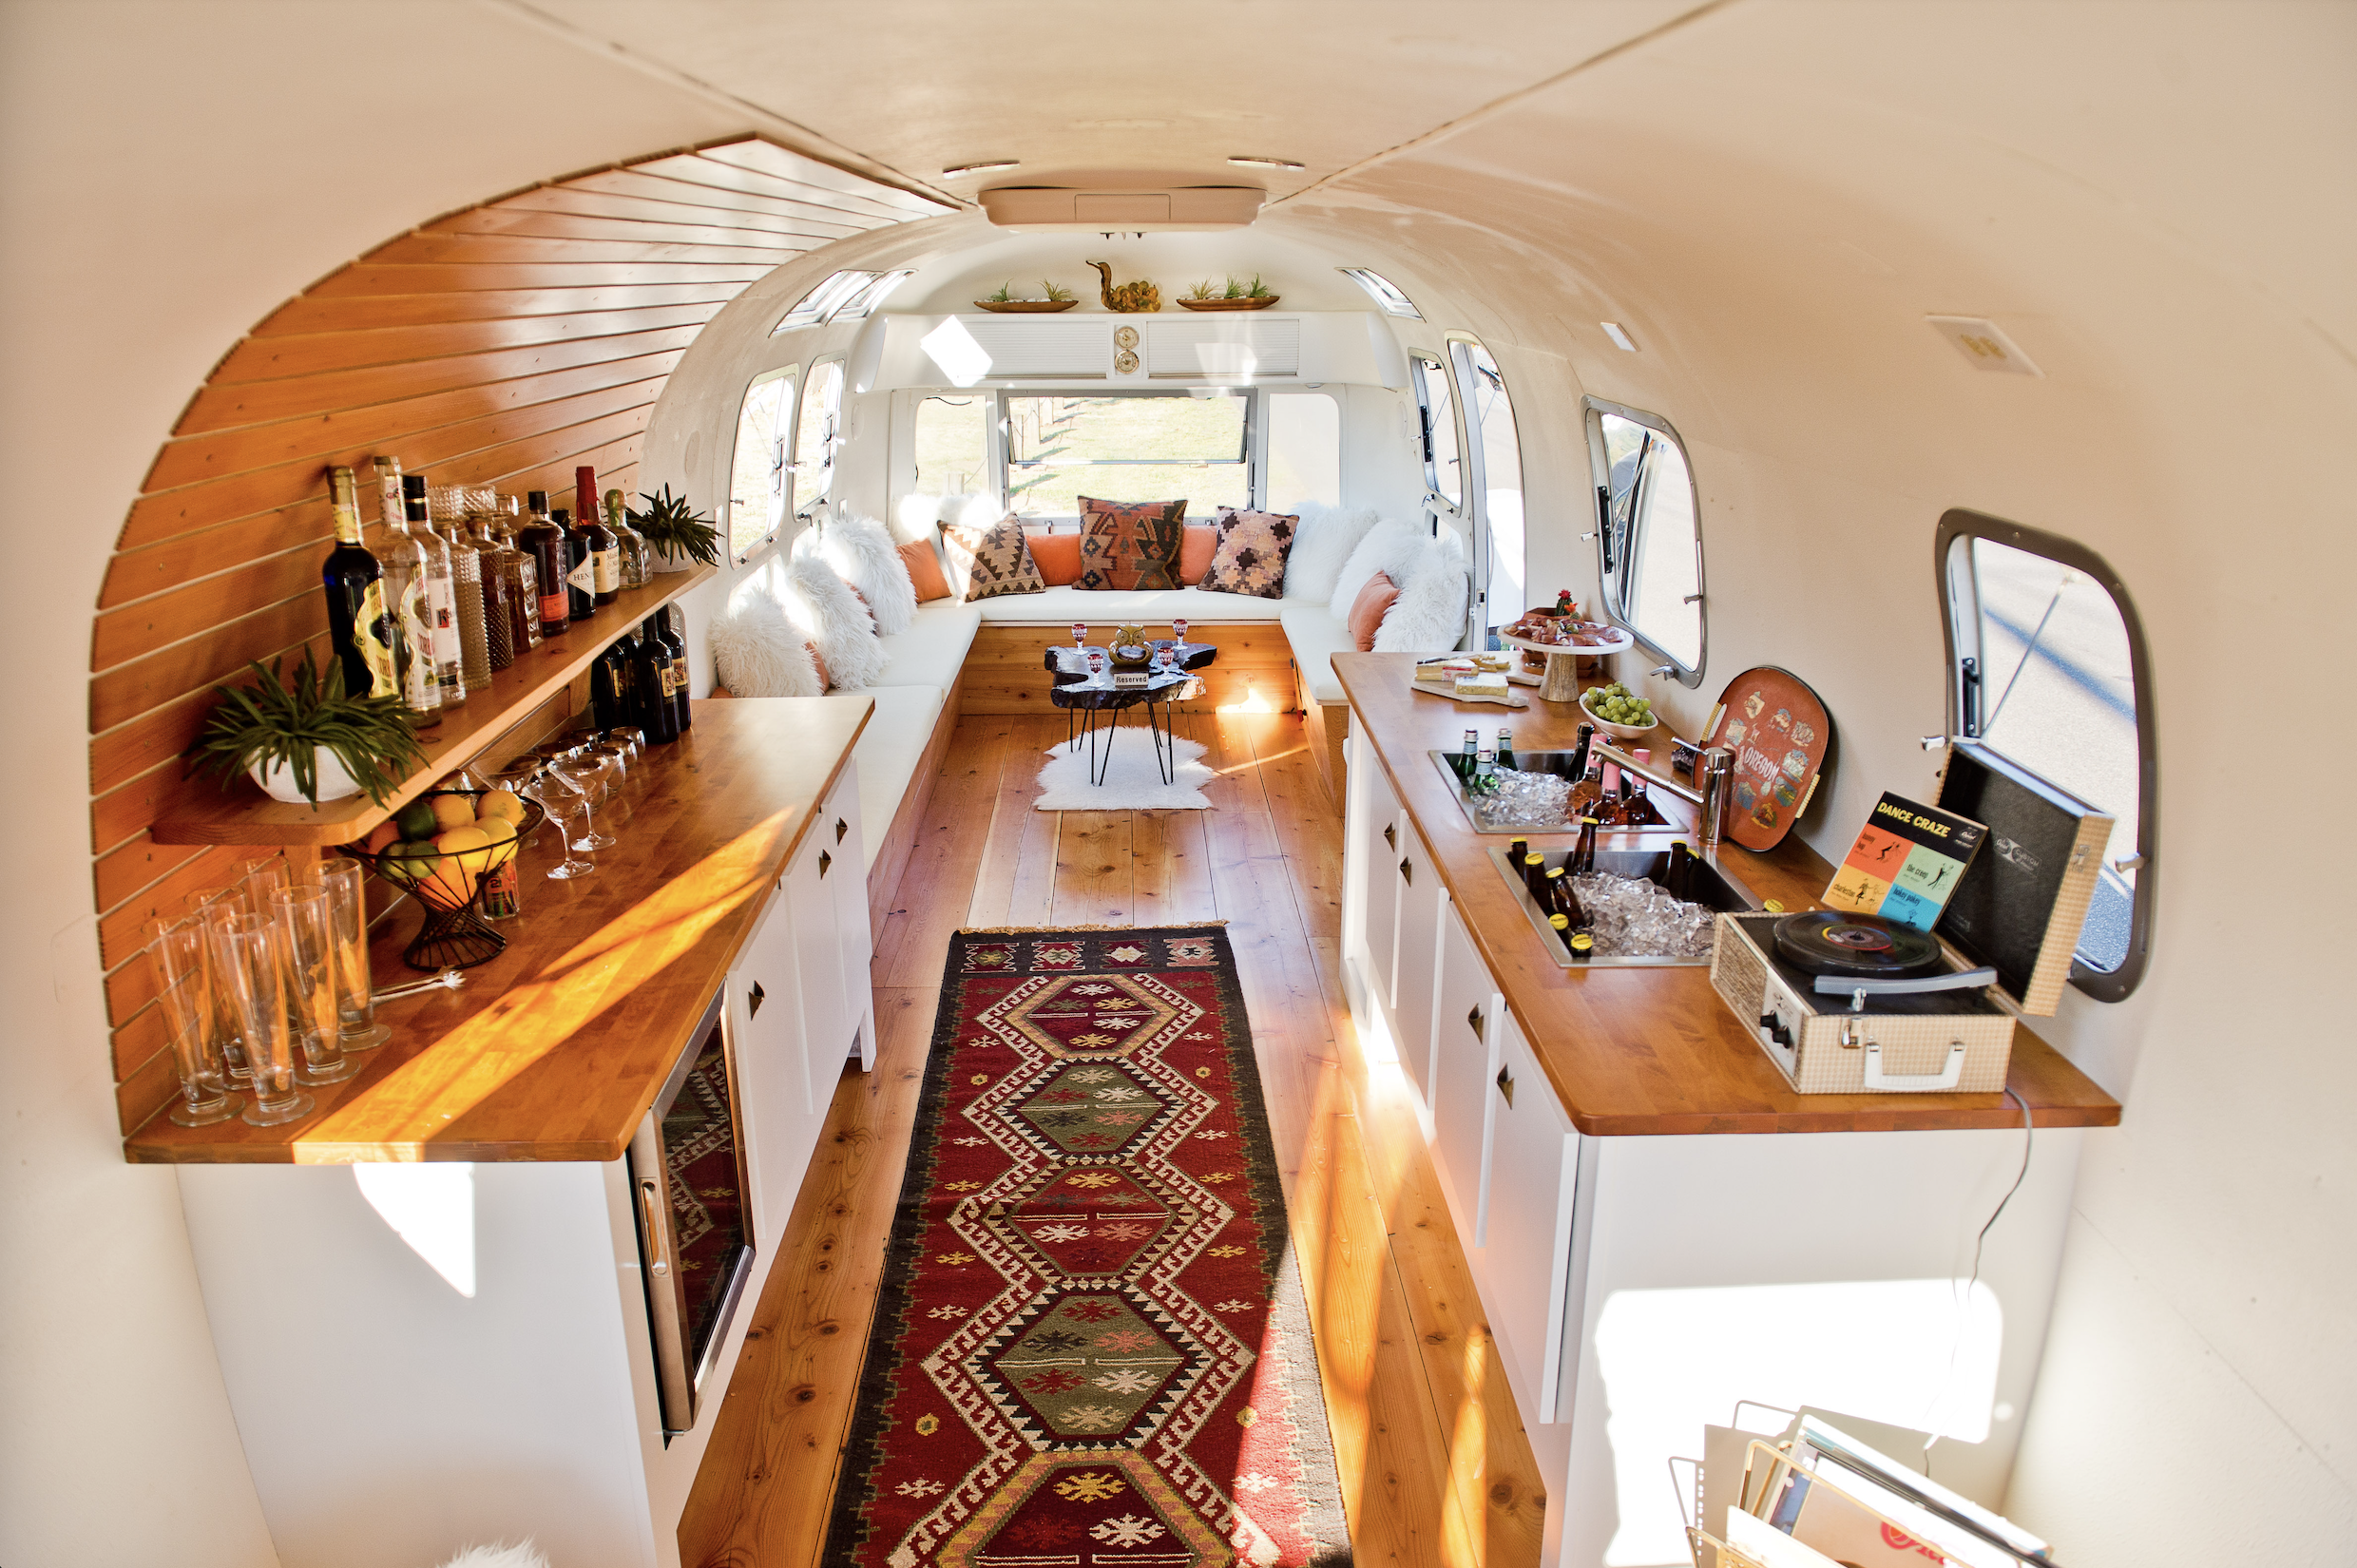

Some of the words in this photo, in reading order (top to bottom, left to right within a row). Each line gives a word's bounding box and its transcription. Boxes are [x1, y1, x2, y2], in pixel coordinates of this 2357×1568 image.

[1744, 746, 1780, 782] OREGON
[1877, 802, 1914, 823] DANCE
[1912, 815, 1951, 838] CRAZE
[1914, 869, 1929, 880] creep
